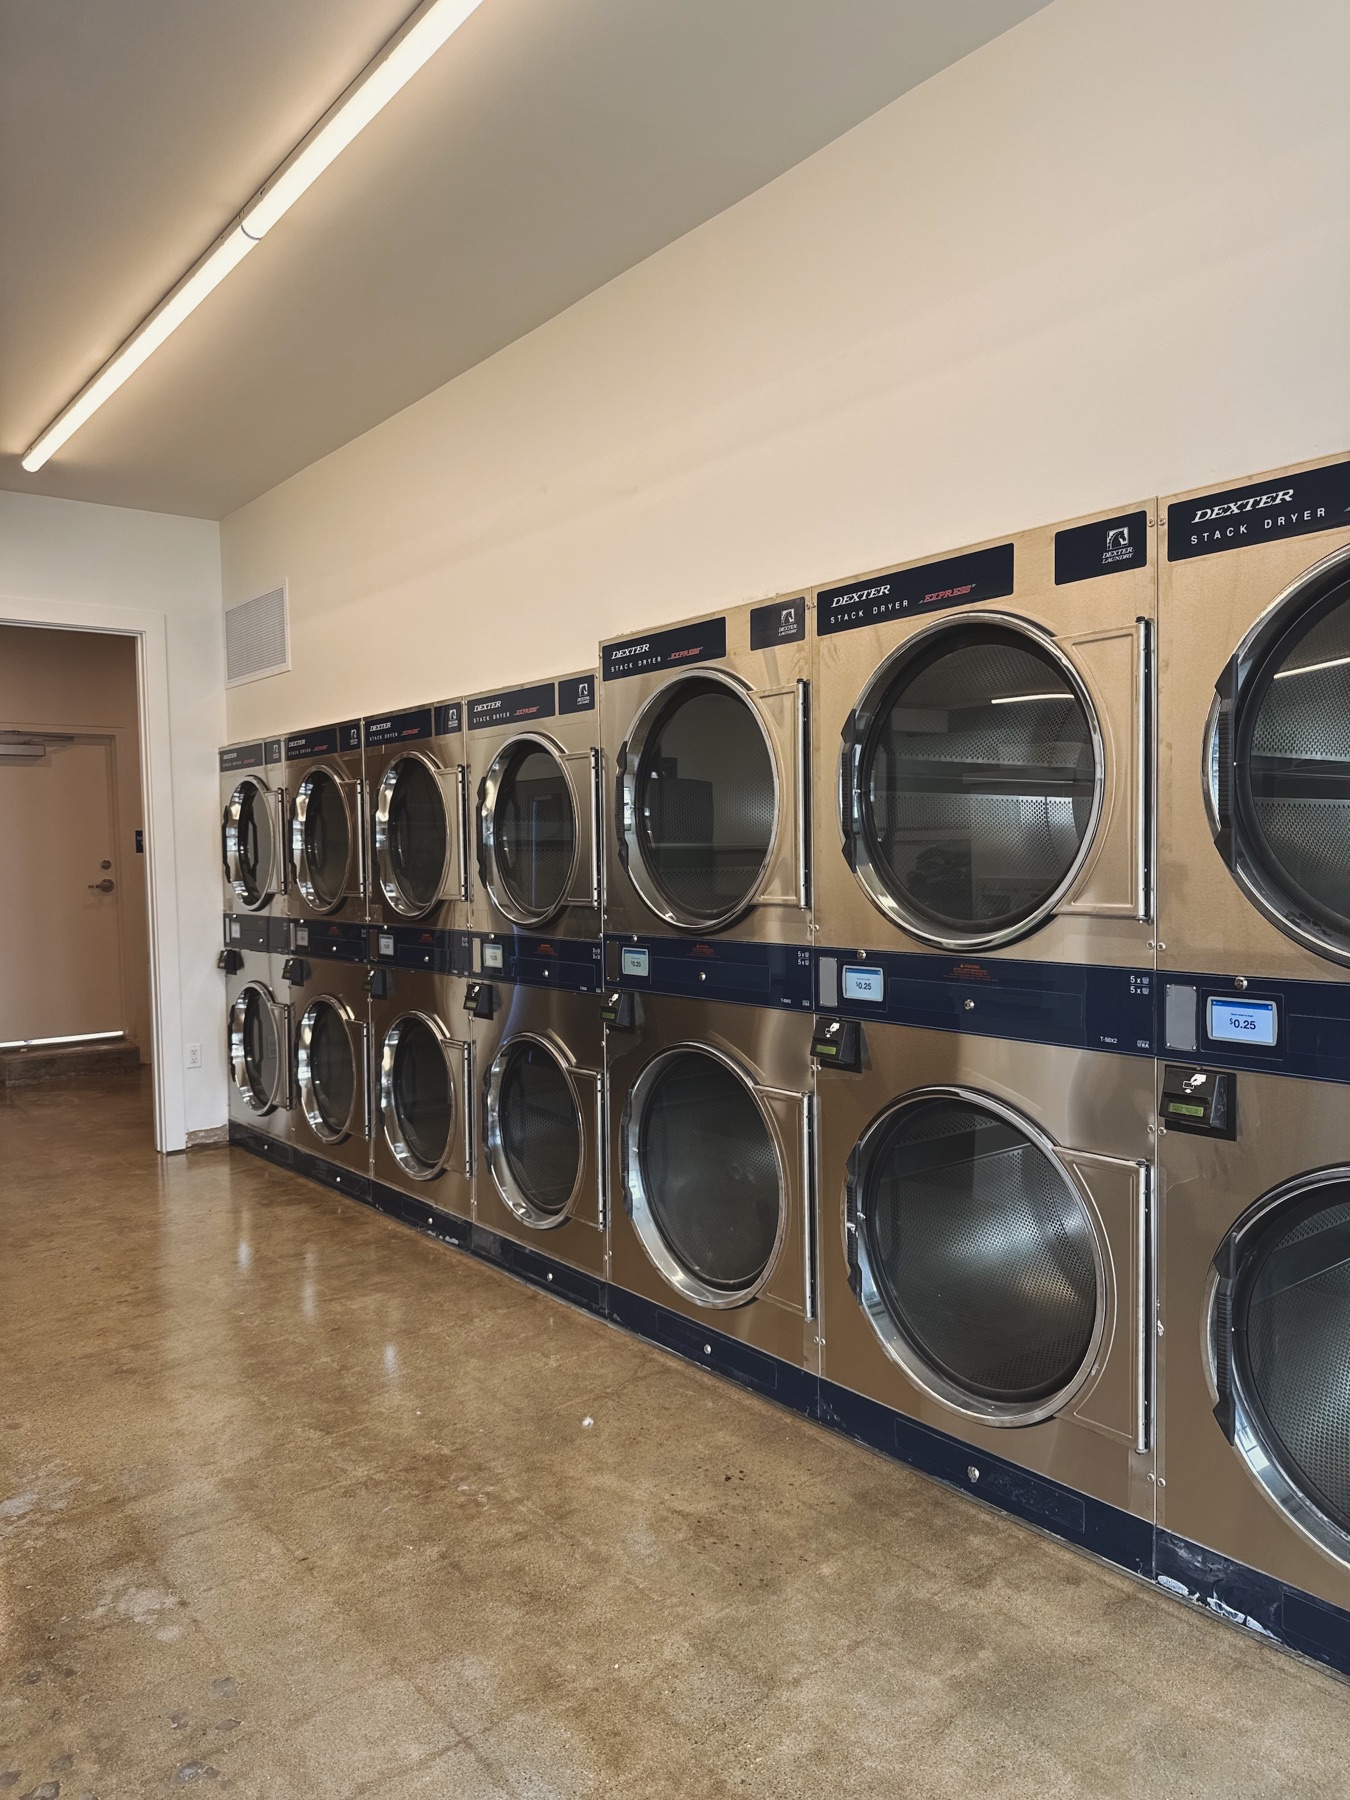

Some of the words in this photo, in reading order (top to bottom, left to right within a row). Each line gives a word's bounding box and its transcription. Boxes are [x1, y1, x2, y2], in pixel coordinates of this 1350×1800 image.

[1191, 488, 1294, 524] DEXTER
[1190, 524, 1248, 545] STACK
[1264, 507, 1326, 529] DRYER
[1102, 547, 1133, 558] DEXTER
[1102, 553, 1134, 564] LAUNDRY
[830, 584, 891, 608] DEXTER
[830, 609, 864, 624] STACK
[872, 599, 908, 614] DRYER
[922, 585, 972, 603] EXPRESS
[611, 643, 650, 660] DEXTER
[611, 662, 633, 673] STACK
[638, 656, 662, 667] DRYER
[473, 700, 502, 713] DEXTER
[855, 981, 872, 991] $0.25
[1130, 975, 1136, 984] 5
[1130, 985, 1136, 994] 5
[1229, 1017, 1257, 1031] $0.25
